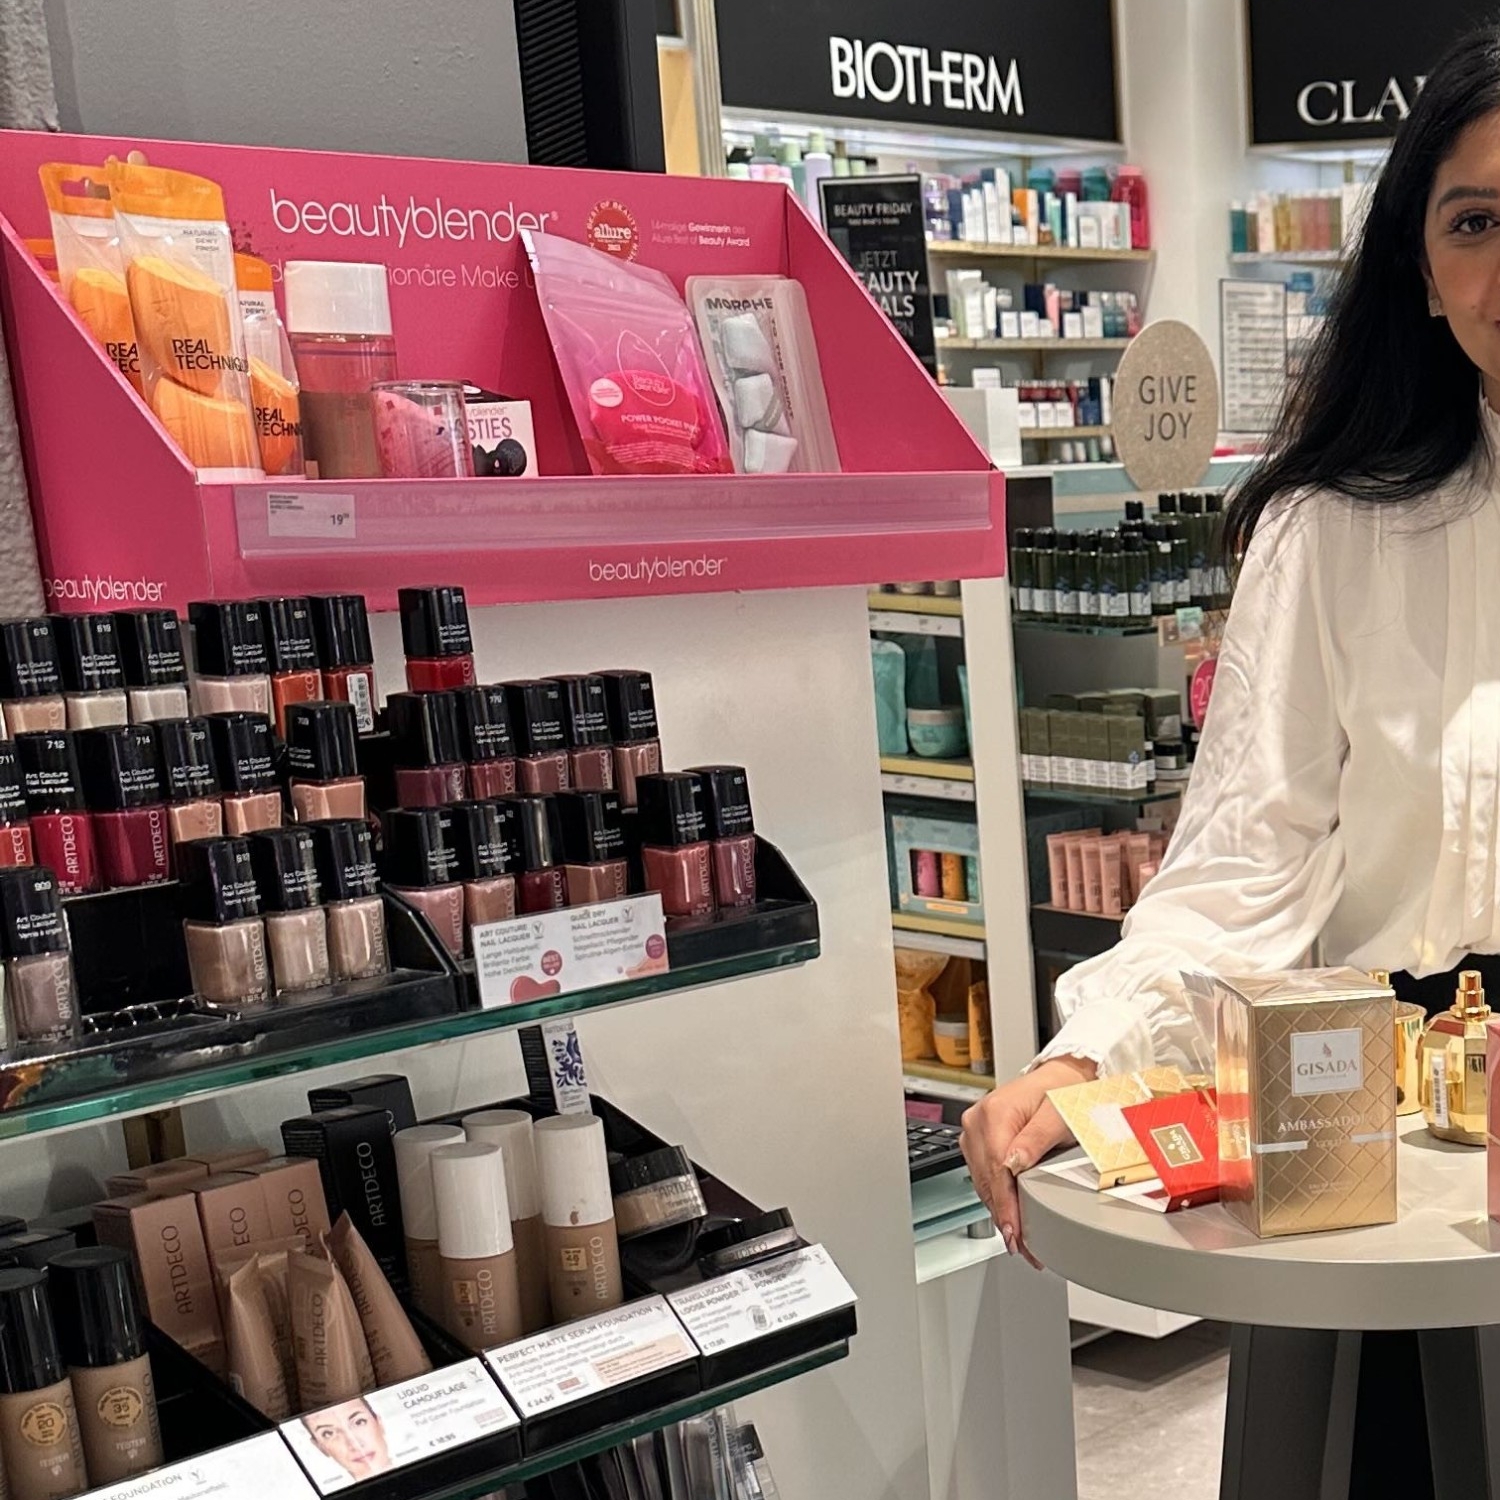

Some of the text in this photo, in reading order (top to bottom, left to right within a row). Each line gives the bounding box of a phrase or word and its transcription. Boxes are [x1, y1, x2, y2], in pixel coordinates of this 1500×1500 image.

[829, 36, 1024, 116] BIOTHERM
[1298, 78, 1428, 125] CLA
[270, 188, 551, 250] beautyblender
[834, 202, 913, 217] BEAUTY FRIDAY
[593, 223, 632, 240] allure
[699, 235, 751, 248] Beauty Award
[859, 250, 898, 268] JETZT
[461, 263, 519, 289] Make
[705, 298, 774, 312] MORPHE
[173, 339, 213, 354] REAL
[1138, 374, 1198, 405] GIVE
[621, 414, 652, 426] POWER
[1144, 411, 1193, 442] JOY
[588, 553, 724, 583] beautyblender
[46, 739, 66, 750] 712
[39, 770, 69, 780] Couture
[59, 815, 80, 876] ARTDECO
[150, 809, 167, 868] ARTDECO
[479, 923, 529, 940] ART COUTURE
[571, 916, 620, 932] NAIL LACQUER
[250, 925, 266, 981] ARTDECO
[480, 932, 531, 948] NAIL LACQUER
[49, 959, 71, 1020] ARTDECO
[1296, 1059, 1358, 1078] GISADA
[1277, 1114, 1372, 1134] AMBASSADO
[357, 1140, 387, 1227] ARTDECO
[160, 1224, 195, 1316] ARTDECO
[588, 1235, 608, 1300] ARTDECO
[753, 1274, 789, 1290] POWDER
[476, 1268, 499, 1337] ARTDECO
[680, 1289, 741, 1316] LOOSE POWDER
[309, 1293, 328, 1368] ARTDECO
[497, 1306, 654, 1365] PERFECT MATTE SERUM FOUNDATION
[396, 1382, 431, 1401] LIQUID
[402, 1380, 468, 1411] CAMOUFLAGE
